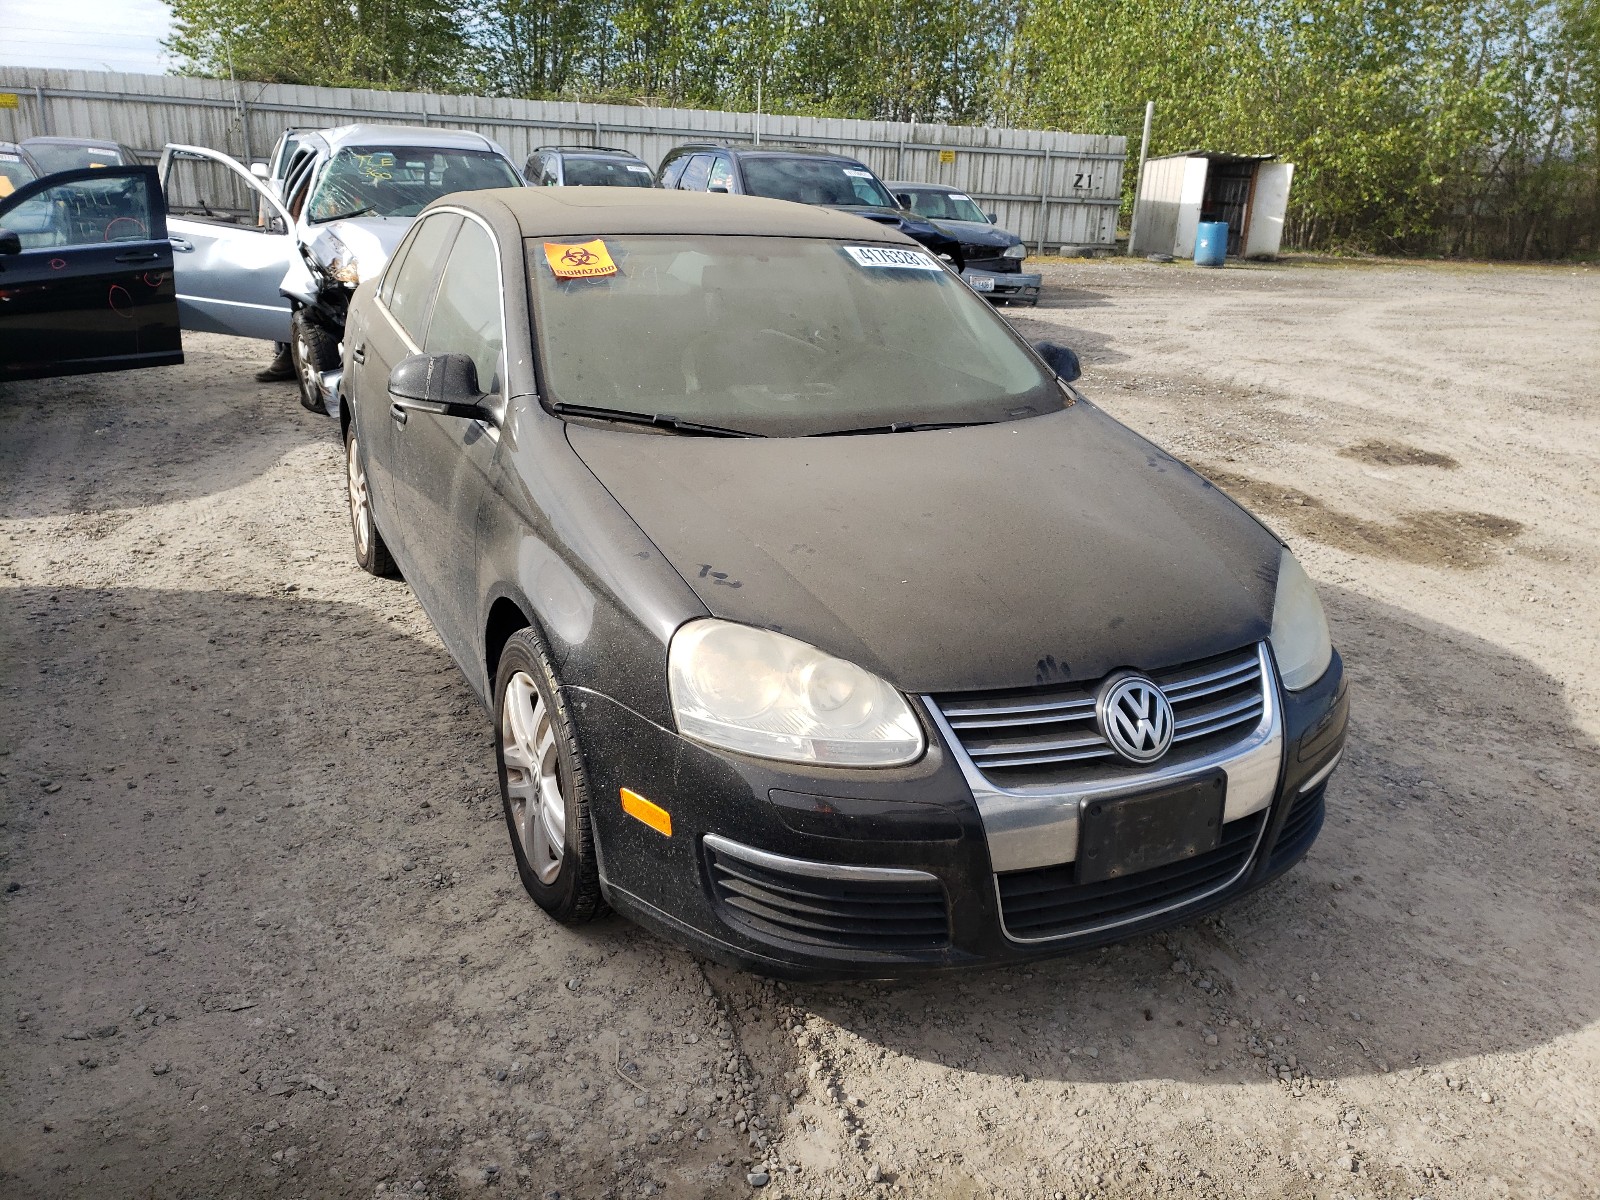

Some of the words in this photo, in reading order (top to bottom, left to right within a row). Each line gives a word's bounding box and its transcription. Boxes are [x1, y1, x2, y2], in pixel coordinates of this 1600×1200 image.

[1073, 173, 1092, 189] Z1
[858, 248, 927, 267] 41763281
[555, 265, 616, 276] BIOHAZARD
[1109, 682, 1170, 757] VW
